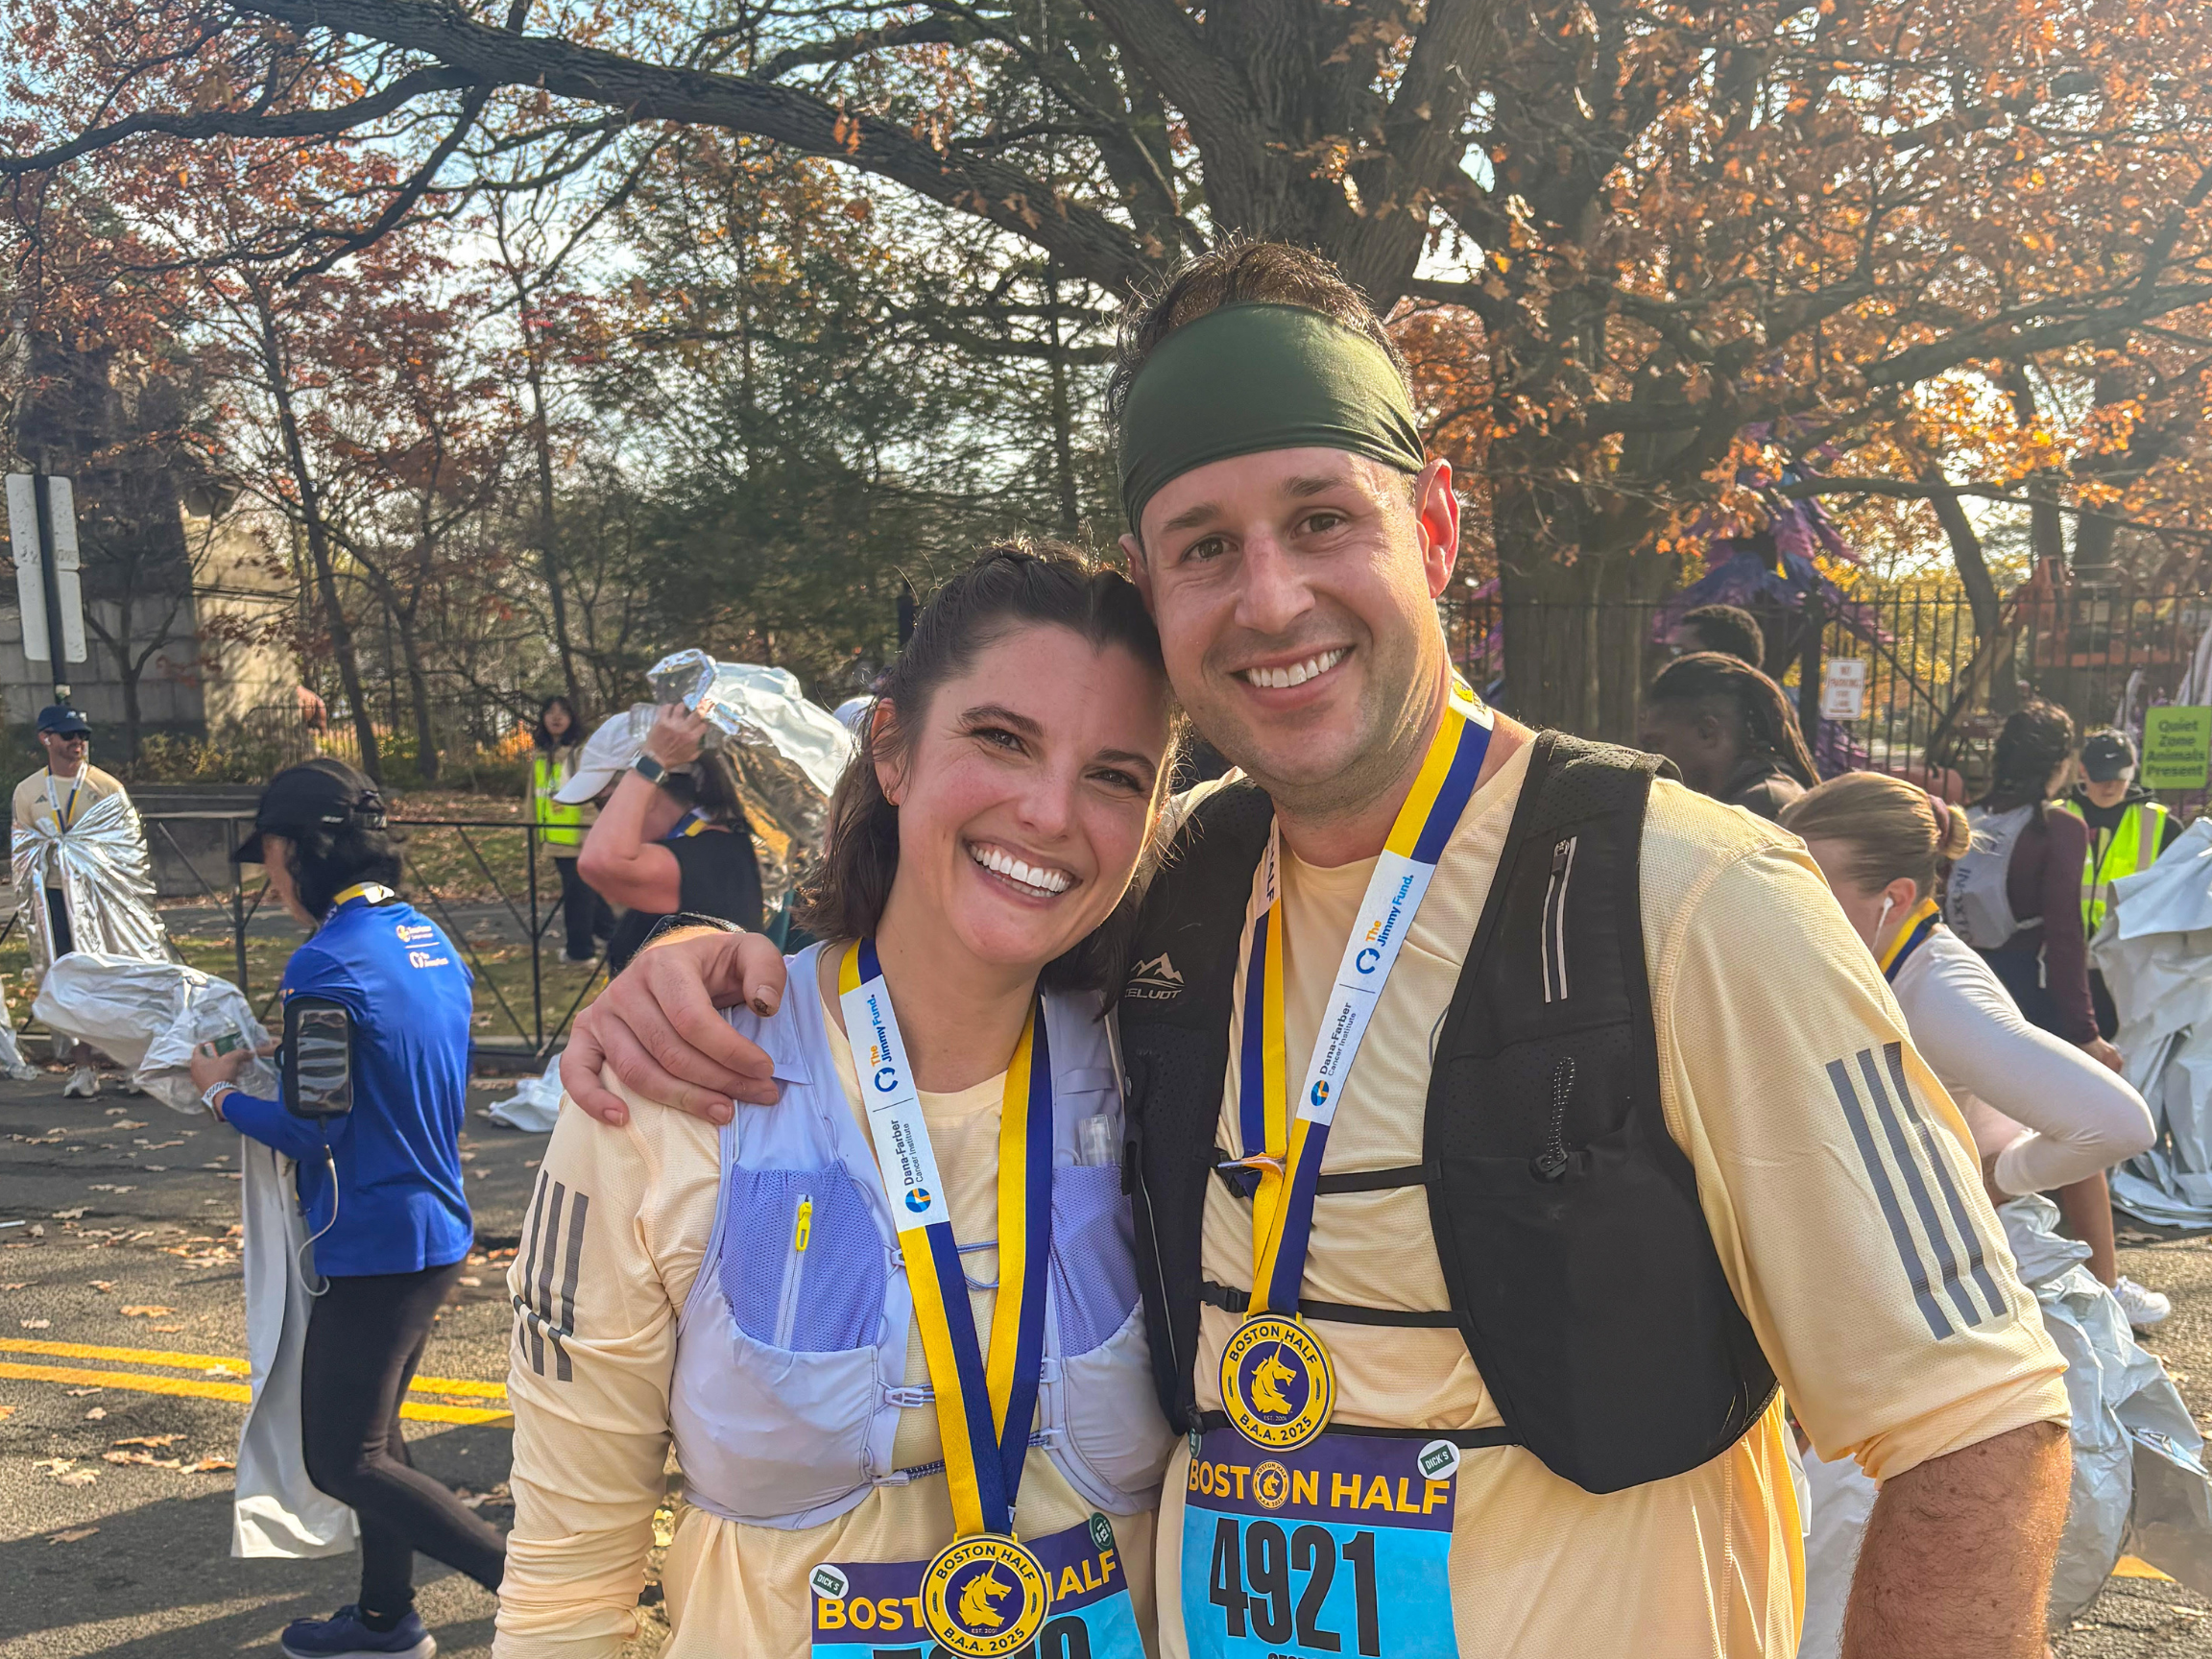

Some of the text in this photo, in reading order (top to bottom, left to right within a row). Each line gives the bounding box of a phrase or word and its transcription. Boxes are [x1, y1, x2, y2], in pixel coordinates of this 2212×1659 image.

[2158, 719, 2199, 733] Quiet
[2158, 734, 2196, 747] Zone
[2146, 748, 2205, 762] Animals
[2146, 764, 2203, 777] Present
[1365, 920, 1382, 942] The
[1377, 906, 1402, 948] Jimmy
[876, 1025, 893, 1063] Jimmy
[1319, 1001, 1353, 1075] Dana-Farber
[1328, 1012, 1357, 1076] Cancer Institute
[871, 1045, 881, 1068] The
[891, 1119, 914, 1187] Dana-Farber
[902, 1123, 924, 1183] Cancer Institute
[1229, 1325, 1317, 1364] BOSTON HALF
[1239, 1413, 1312, 1441] B.A.A. 2025
[1425, 1451, 1450, 1470] DICK'S
[1331, 1473, 1451, 1514] HALF
[935, 1546, 1036, 1581] BOSTON HALF
[817, 1574, 840, 1591] DICK'S
[1209, 1517, 1381, 1657] 4921
[818, 1597, 925, 1631] BOST
[943, 1627, 984, 1651] B.A.A.
[989, 1627, 1025, 1652] 2025
